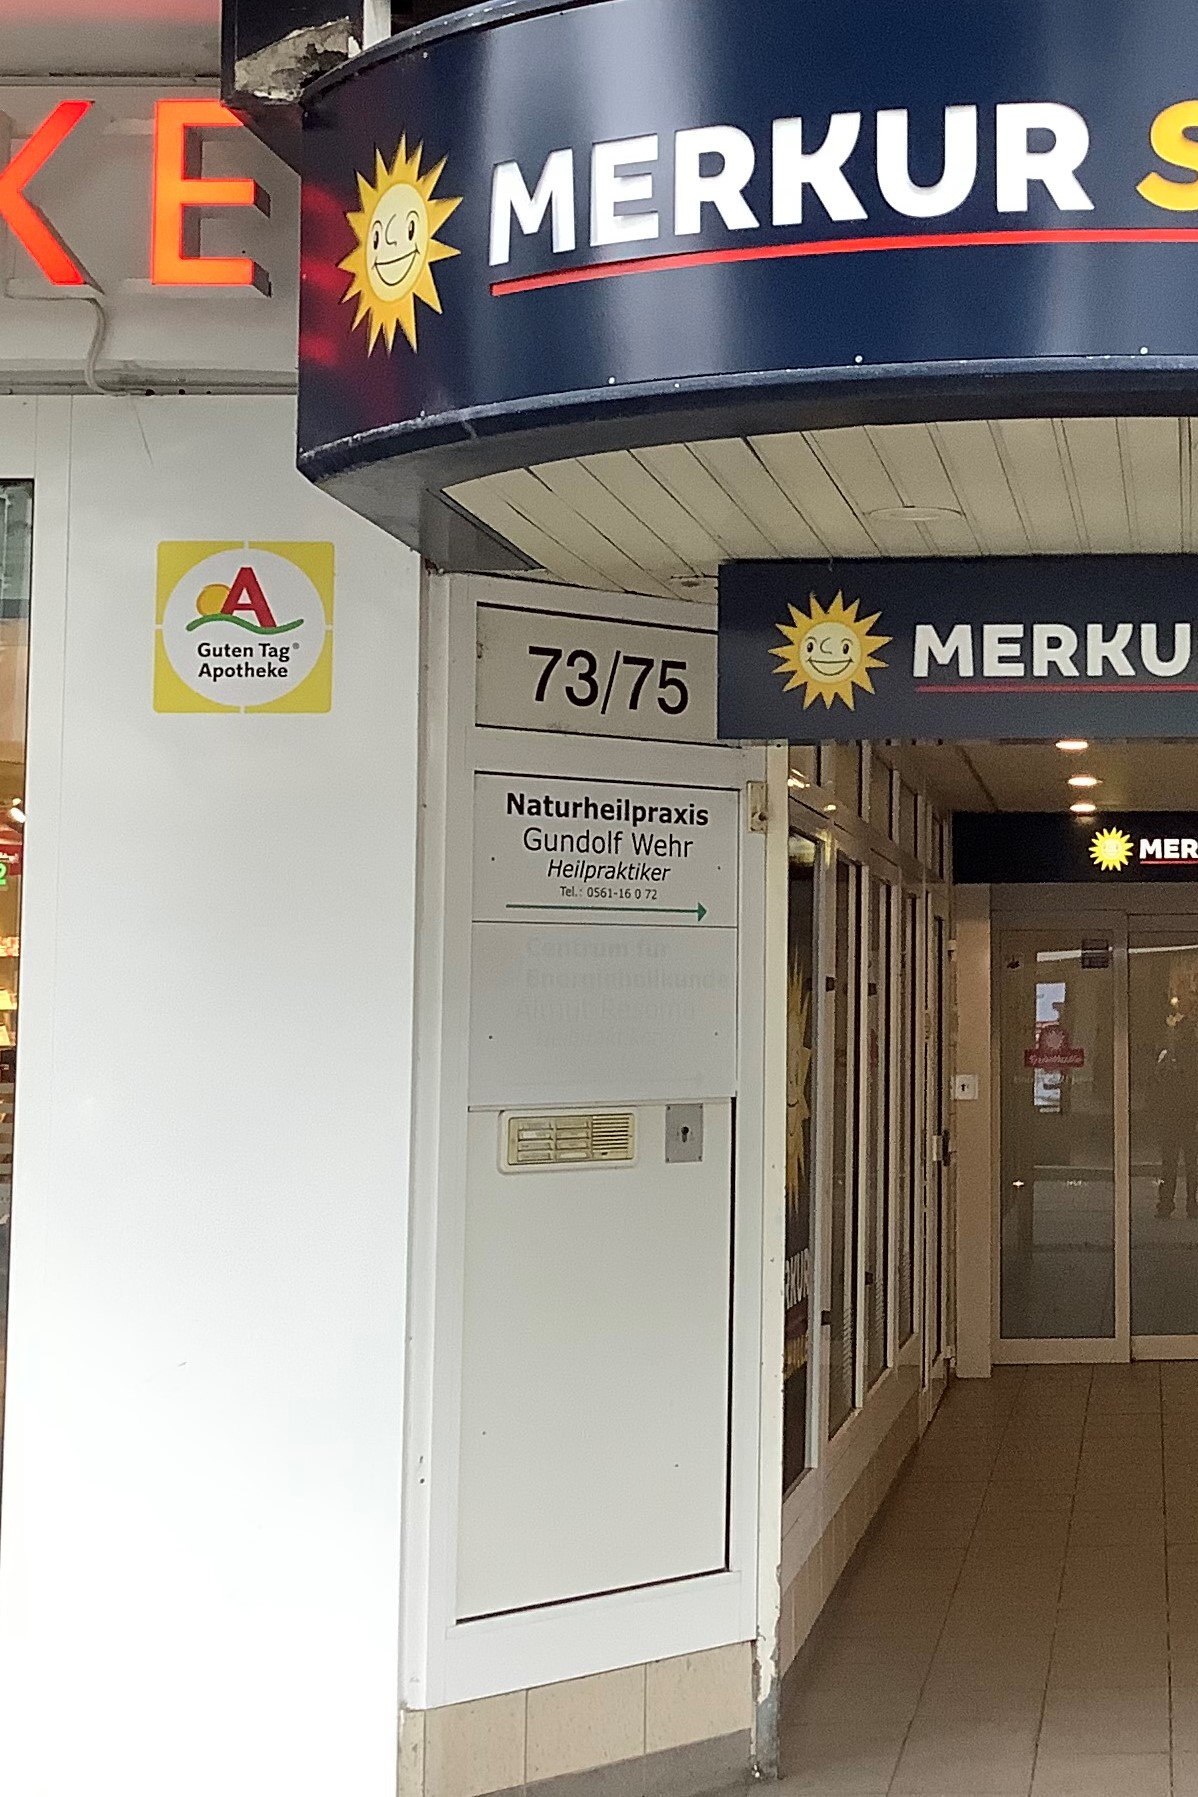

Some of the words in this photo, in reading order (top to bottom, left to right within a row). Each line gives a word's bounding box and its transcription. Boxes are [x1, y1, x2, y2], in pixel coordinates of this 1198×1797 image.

[489, 101, 1095, 267] MERKUR
[197, 642, 254, 658] Guten
[258, 642, 290, 663] Tag
[198, 661, 288, 682] Apotheke
[528, 645, 689, 715] 73/75
[506, 792, 709, 827] Naturheilpraxis
[523, 827, 624, 854] Gundolf
[631, 832, 694, 857] Wehr
[547, 859, 671, 882] Heilpraktiker
[586, 886, 631, 899] 0561-16
[634, 888, 642, 899] 0
[645, 888, 658, 900] 72
